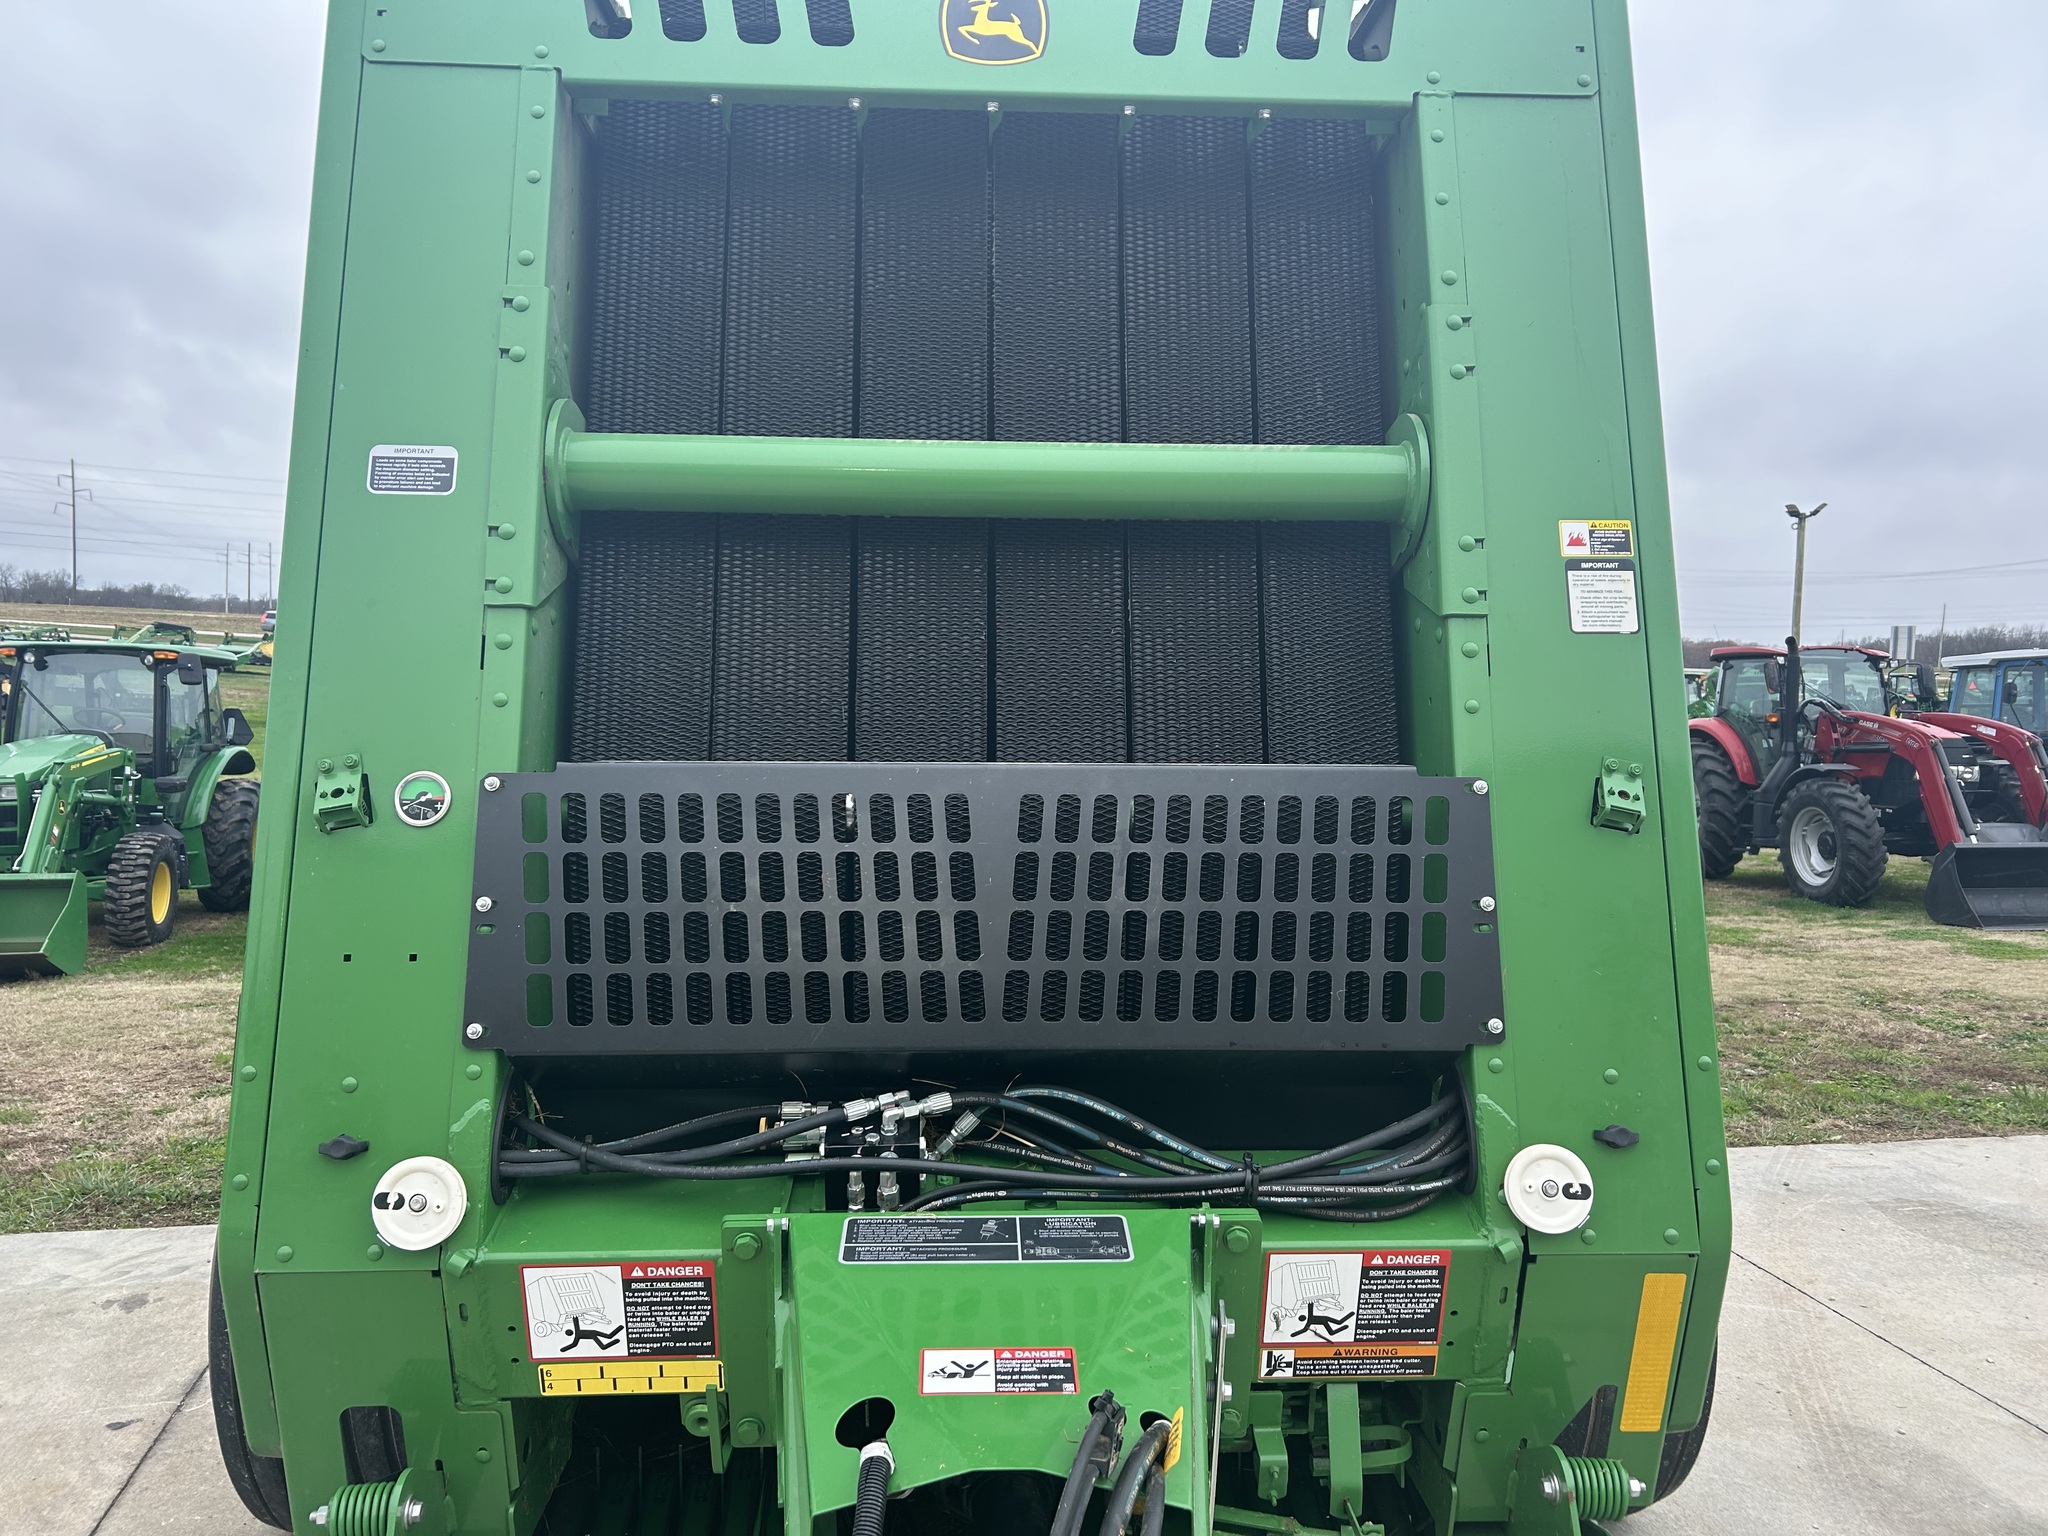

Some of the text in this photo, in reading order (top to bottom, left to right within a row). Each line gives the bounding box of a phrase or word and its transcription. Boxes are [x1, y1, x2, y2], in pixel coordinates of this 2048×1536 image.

[1041, 1154, 1061, 1163] Resistant
[1387, 1255, 1440, 1264] DANGER
[647, 1266, 703, 1276] DANGER
